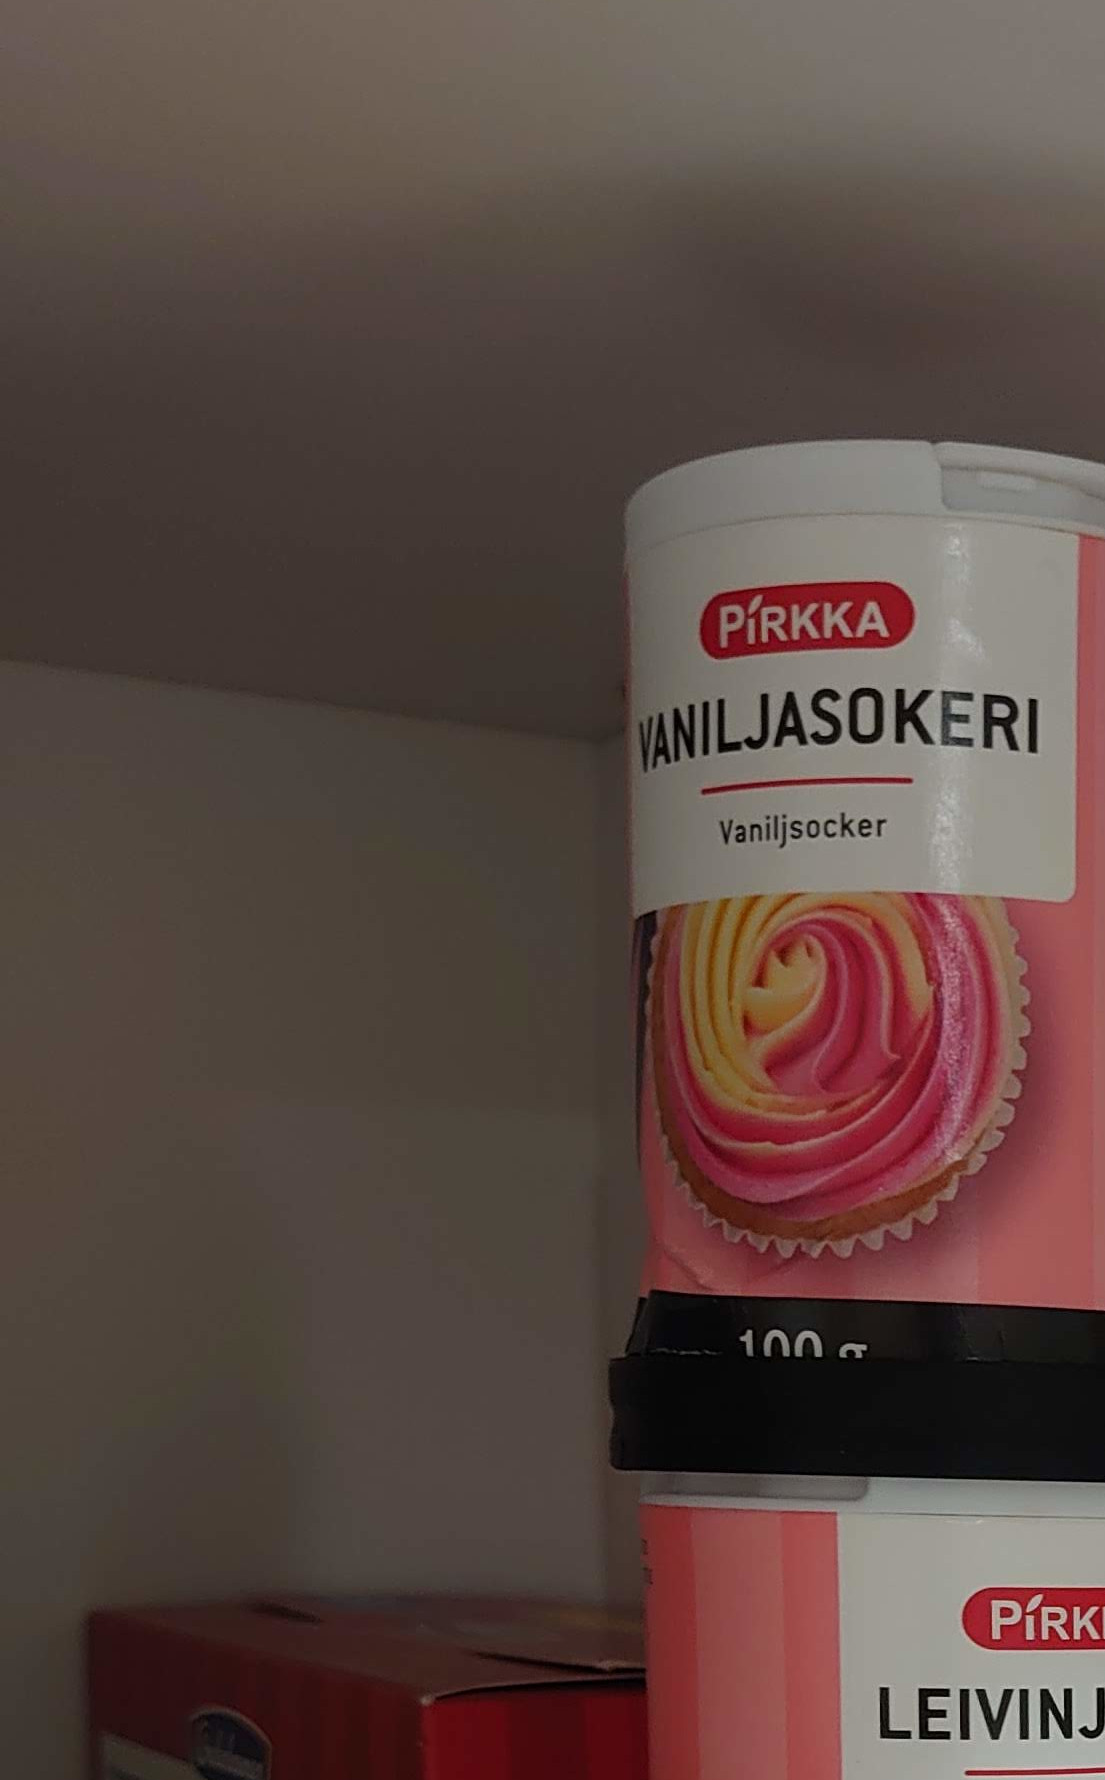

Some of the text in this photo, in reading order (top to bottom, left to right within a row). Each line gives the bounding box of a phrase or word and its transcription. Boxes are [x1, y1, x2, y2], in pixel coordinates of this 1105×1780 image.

[637, 687, 1040, 773] VANILJASOKERI
[718, 812, 888, 849] Vaniljsocker
[739, 1329, 823, 1358] 100
